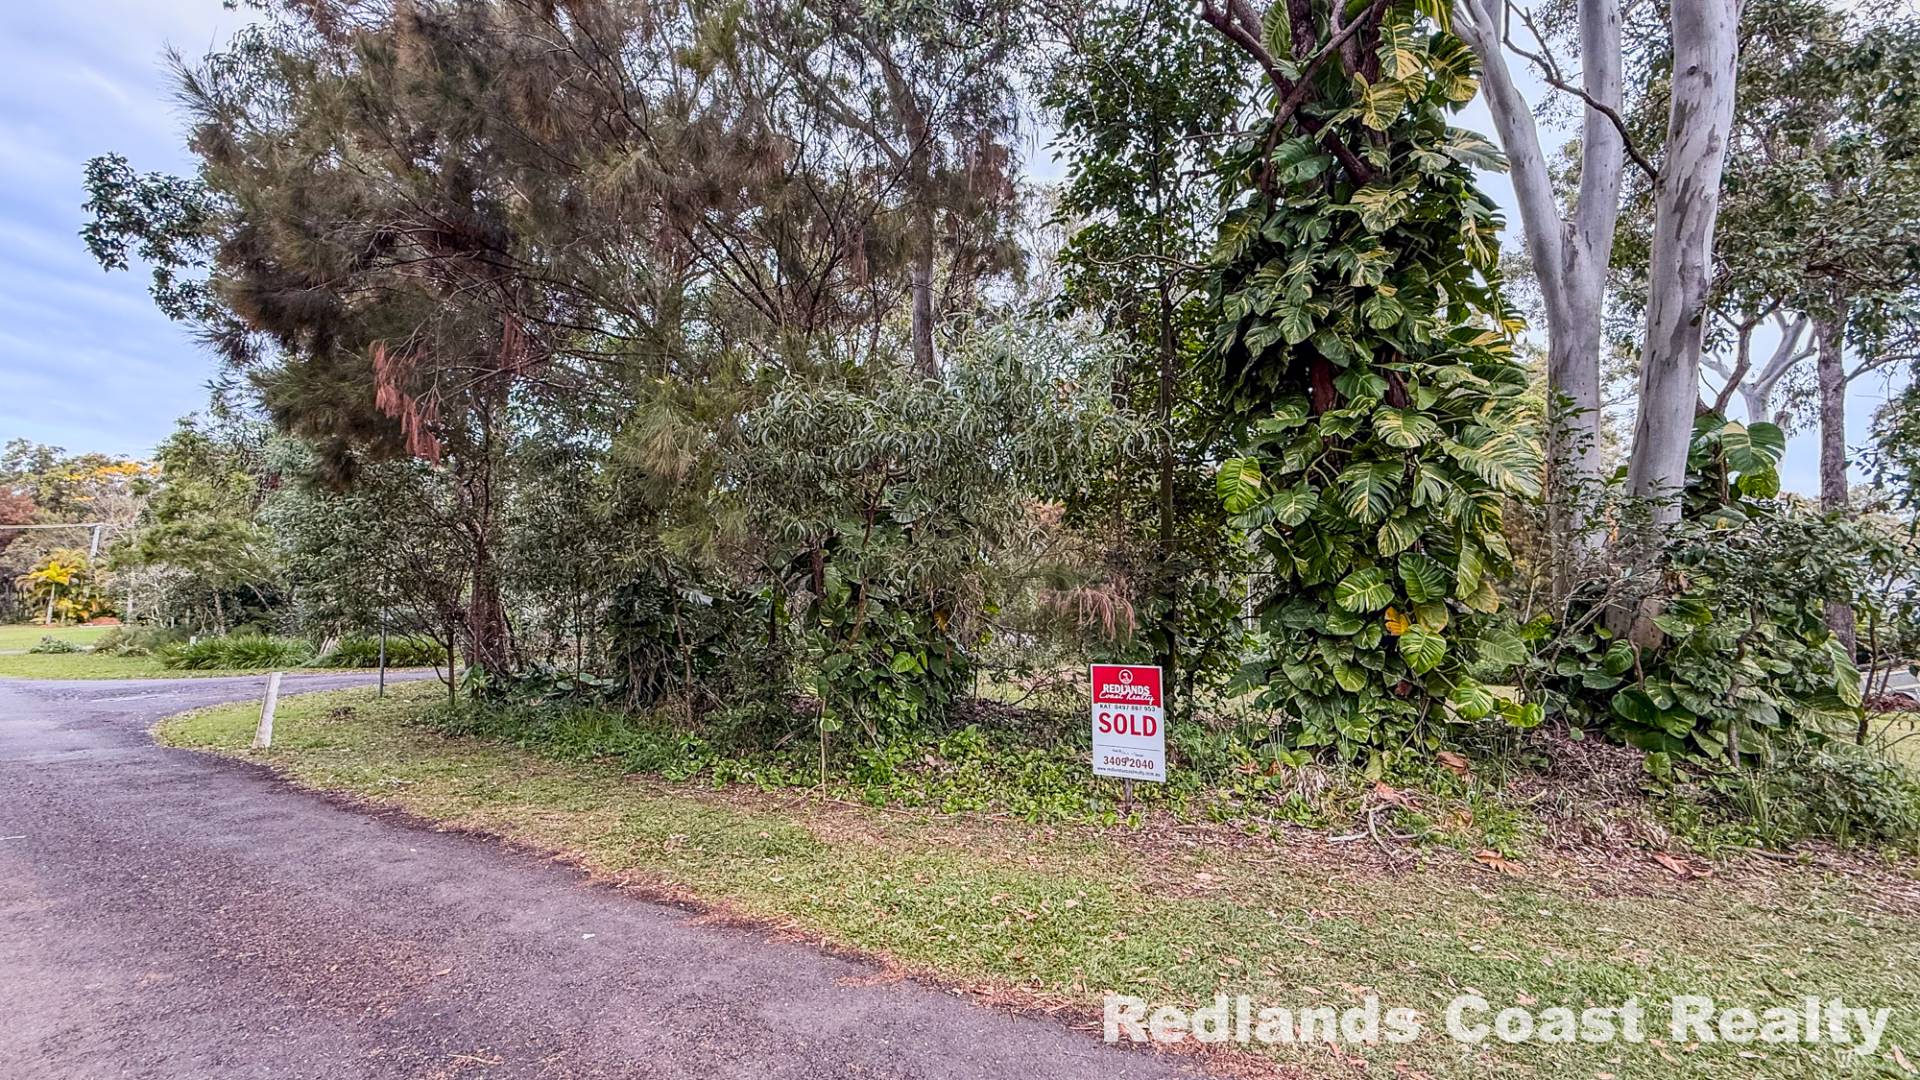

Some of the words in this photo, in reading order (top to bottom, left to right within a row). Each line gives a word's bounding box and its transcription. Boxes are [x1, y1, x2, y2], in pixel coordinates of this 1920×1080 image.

[1102, 684, 1151, 695] REDLANDS
[1099, 691, 1124, 699] Coast
[1126, 693, 1155, 705] Realty
[1099, 712, 1157, 737] SOLD
[1103, 756, 1127, 767] 3409
[1129, 758, 1154, 770] 2040
